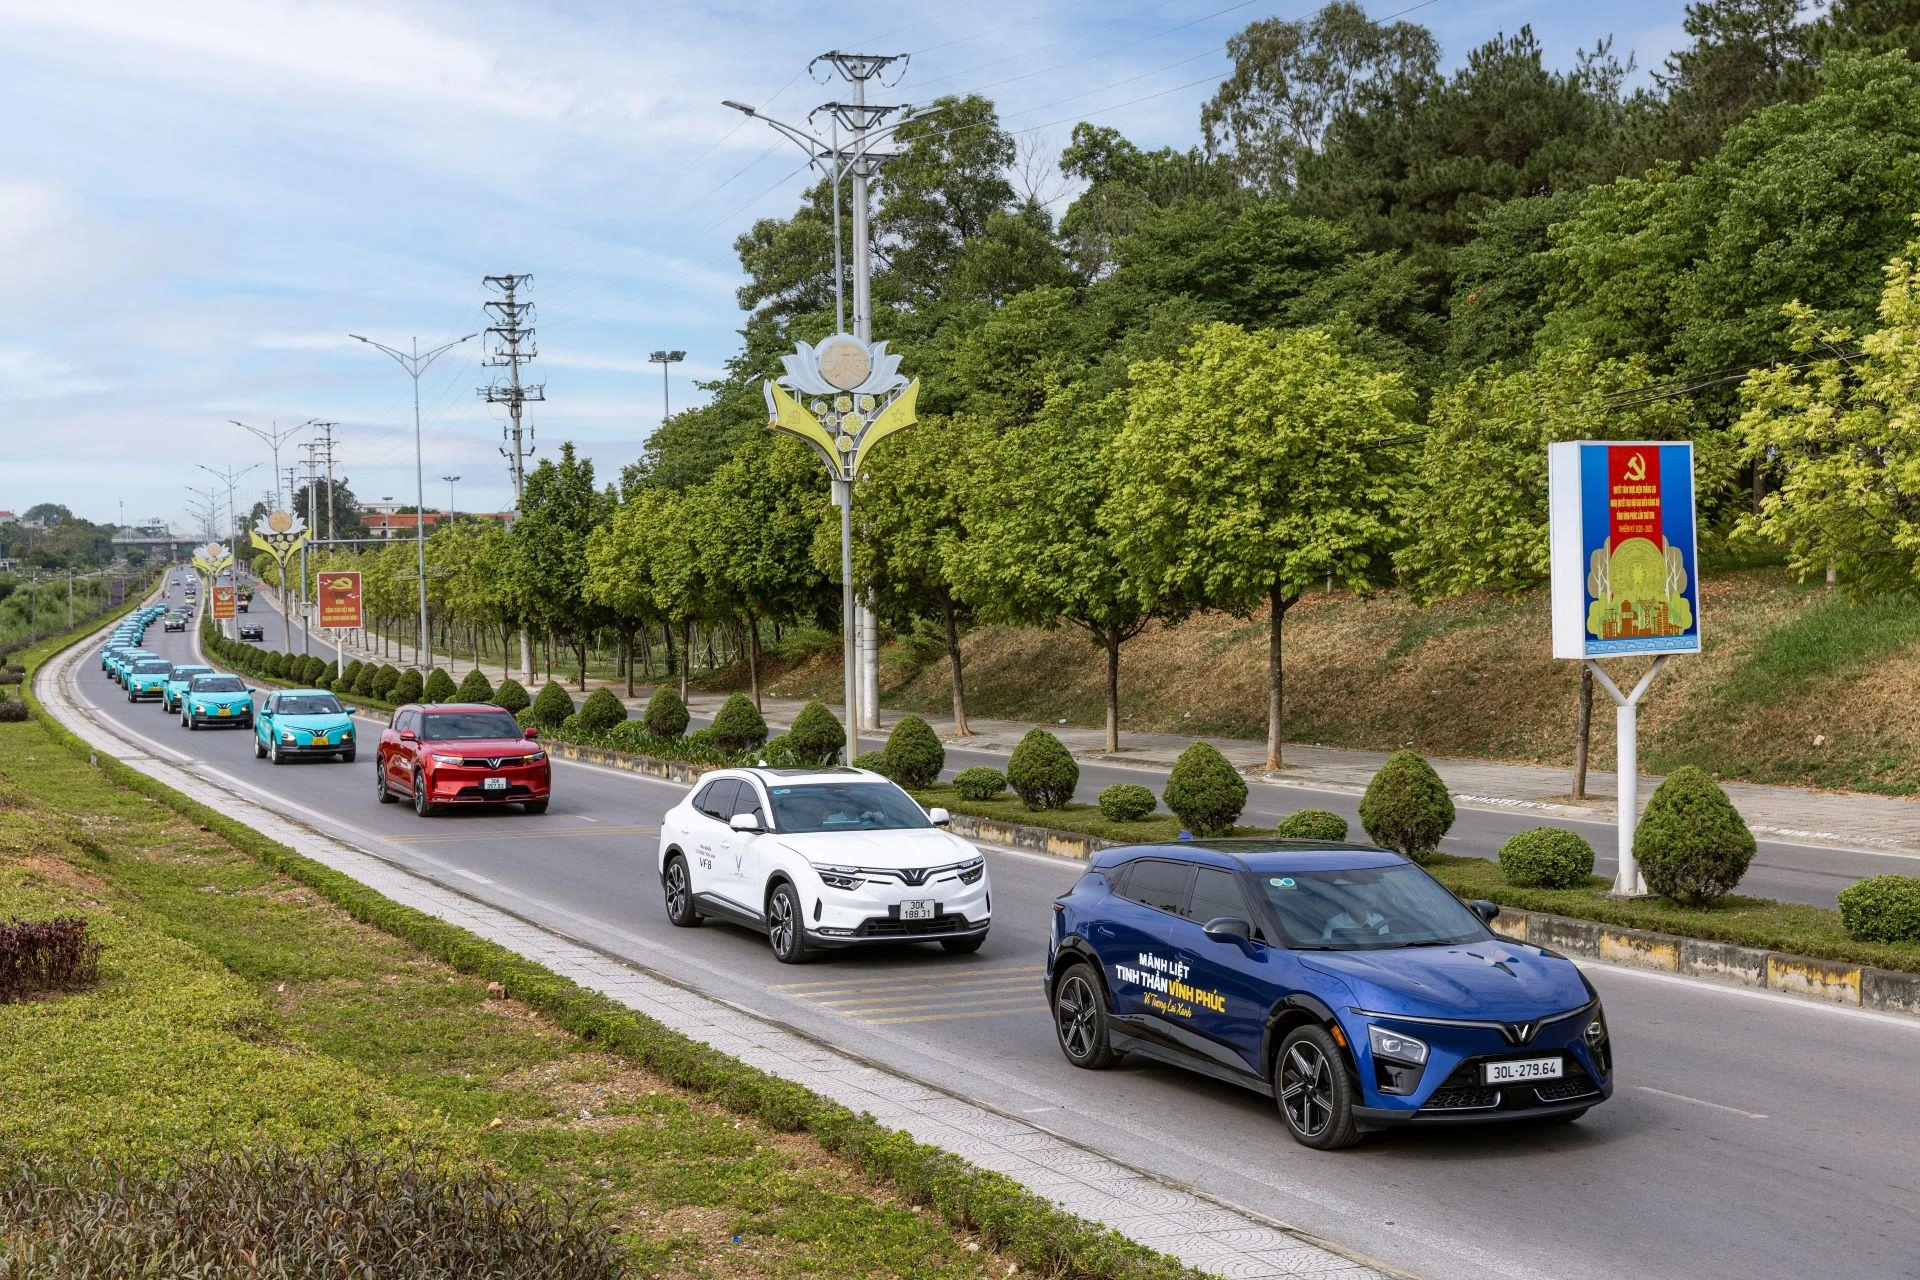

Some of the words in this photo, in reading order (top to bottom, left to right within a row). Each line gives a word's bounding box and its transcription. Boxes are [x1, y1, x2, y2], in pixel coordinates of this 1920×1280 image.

[910, 901, 925, 910] 30K
[905, 909, 930, 919] 188.31
[1169, 961, 1190, 980] LIỆT
[1115, 964, 1140, 985] TINH
[1140, 970, 1168, 993] THẦN
[1168, 978, 1194, 1003] VĨNH
[1195, 988, 1226, 1013] PHÚC
